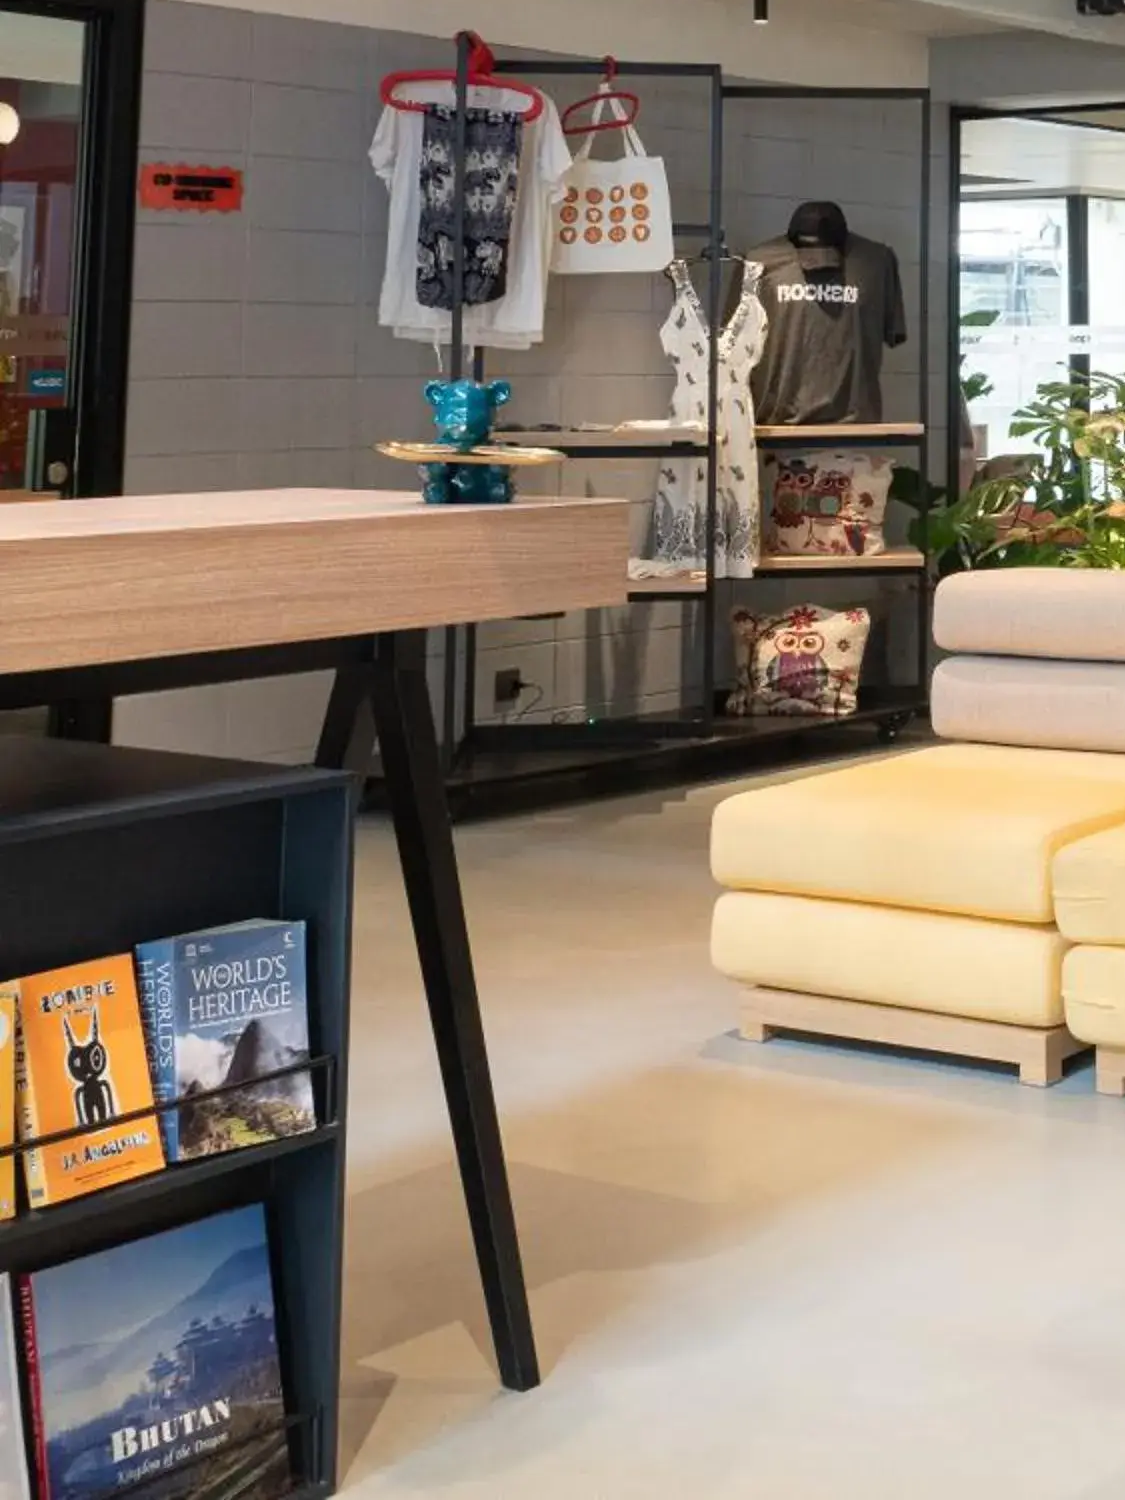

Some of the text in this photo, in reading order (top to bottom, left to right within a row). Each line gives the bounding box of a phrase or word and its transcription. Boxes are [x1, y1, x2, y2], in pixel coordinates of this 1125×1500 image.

[191, 955, 288, 992] WORLD'S
[156, 962, 174, 1068] WORLD'S
[188, 981, 293, 1023] HERITAGE
[111, 1397, 231, 1464] BHUTAN
